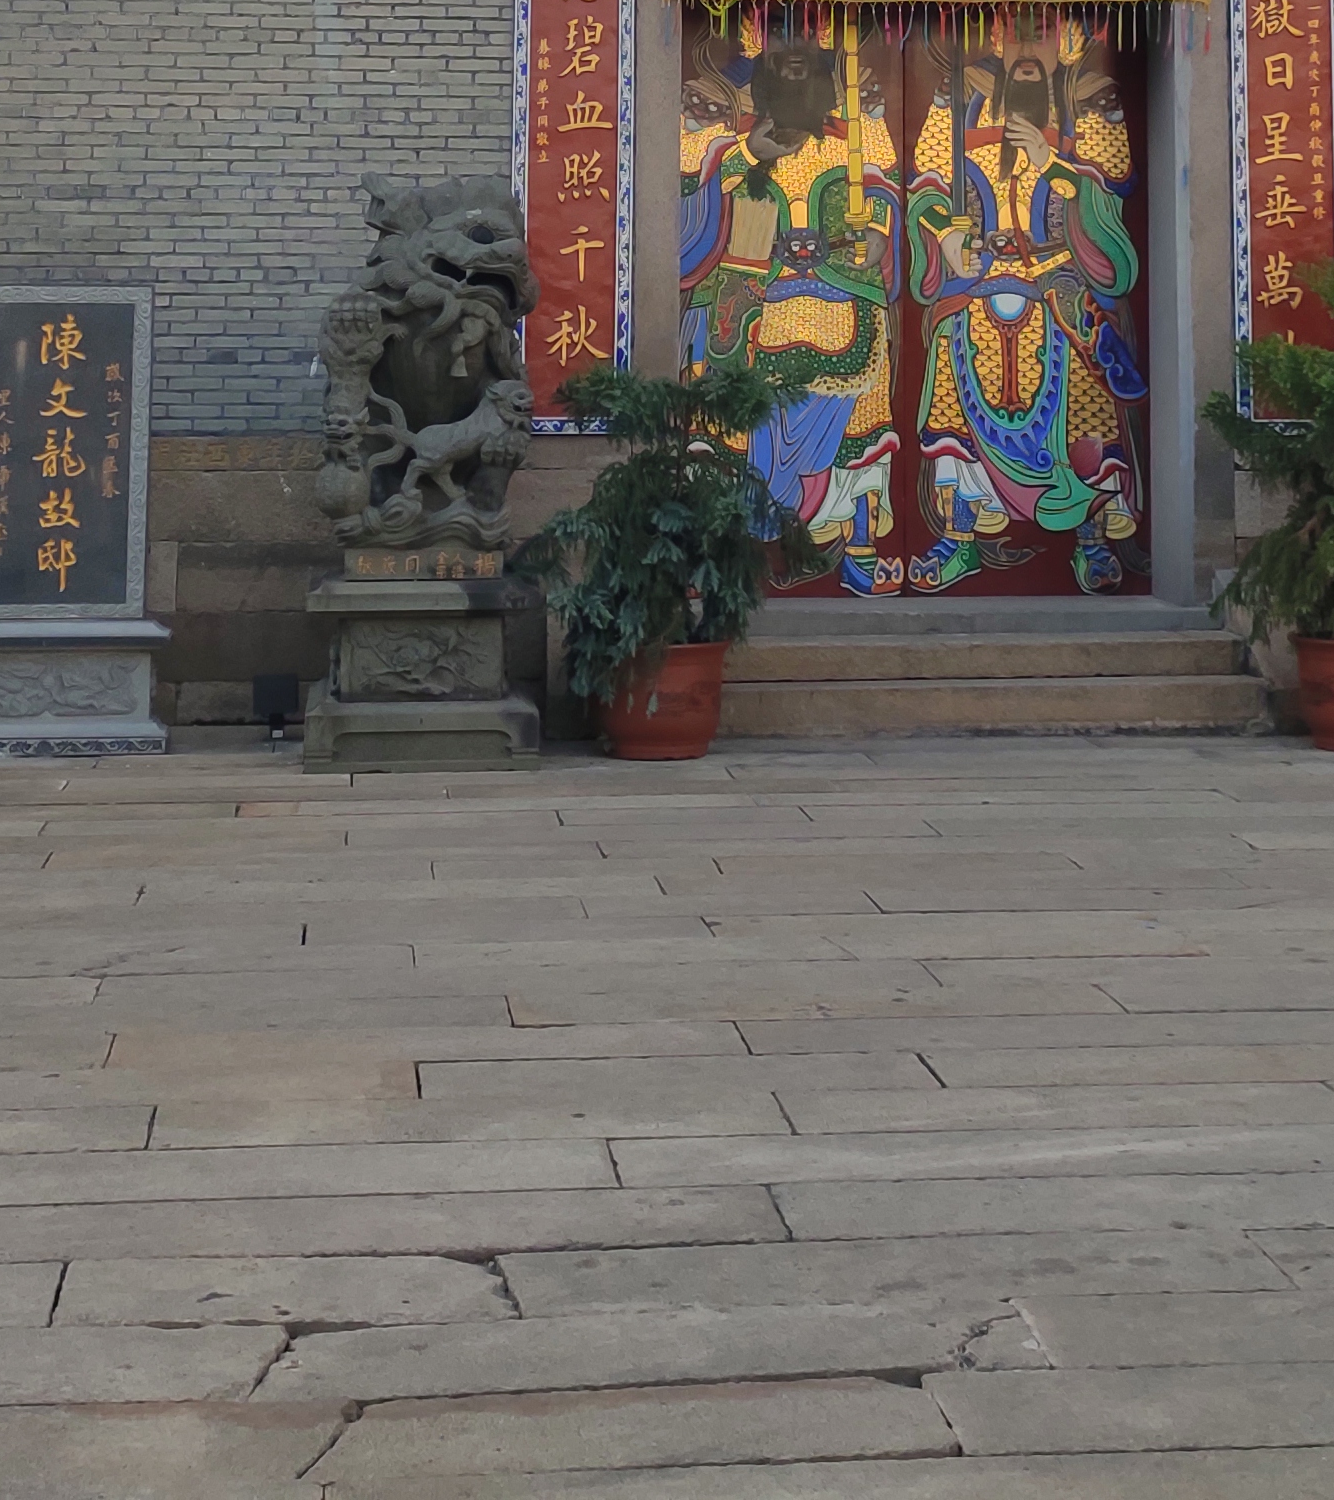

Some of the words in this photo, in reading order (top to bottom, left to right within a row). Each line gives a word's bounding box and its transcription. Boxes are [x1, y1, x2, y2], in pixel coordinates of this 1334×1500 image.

[32, 313, 88, 593] 陳文龍故邸
